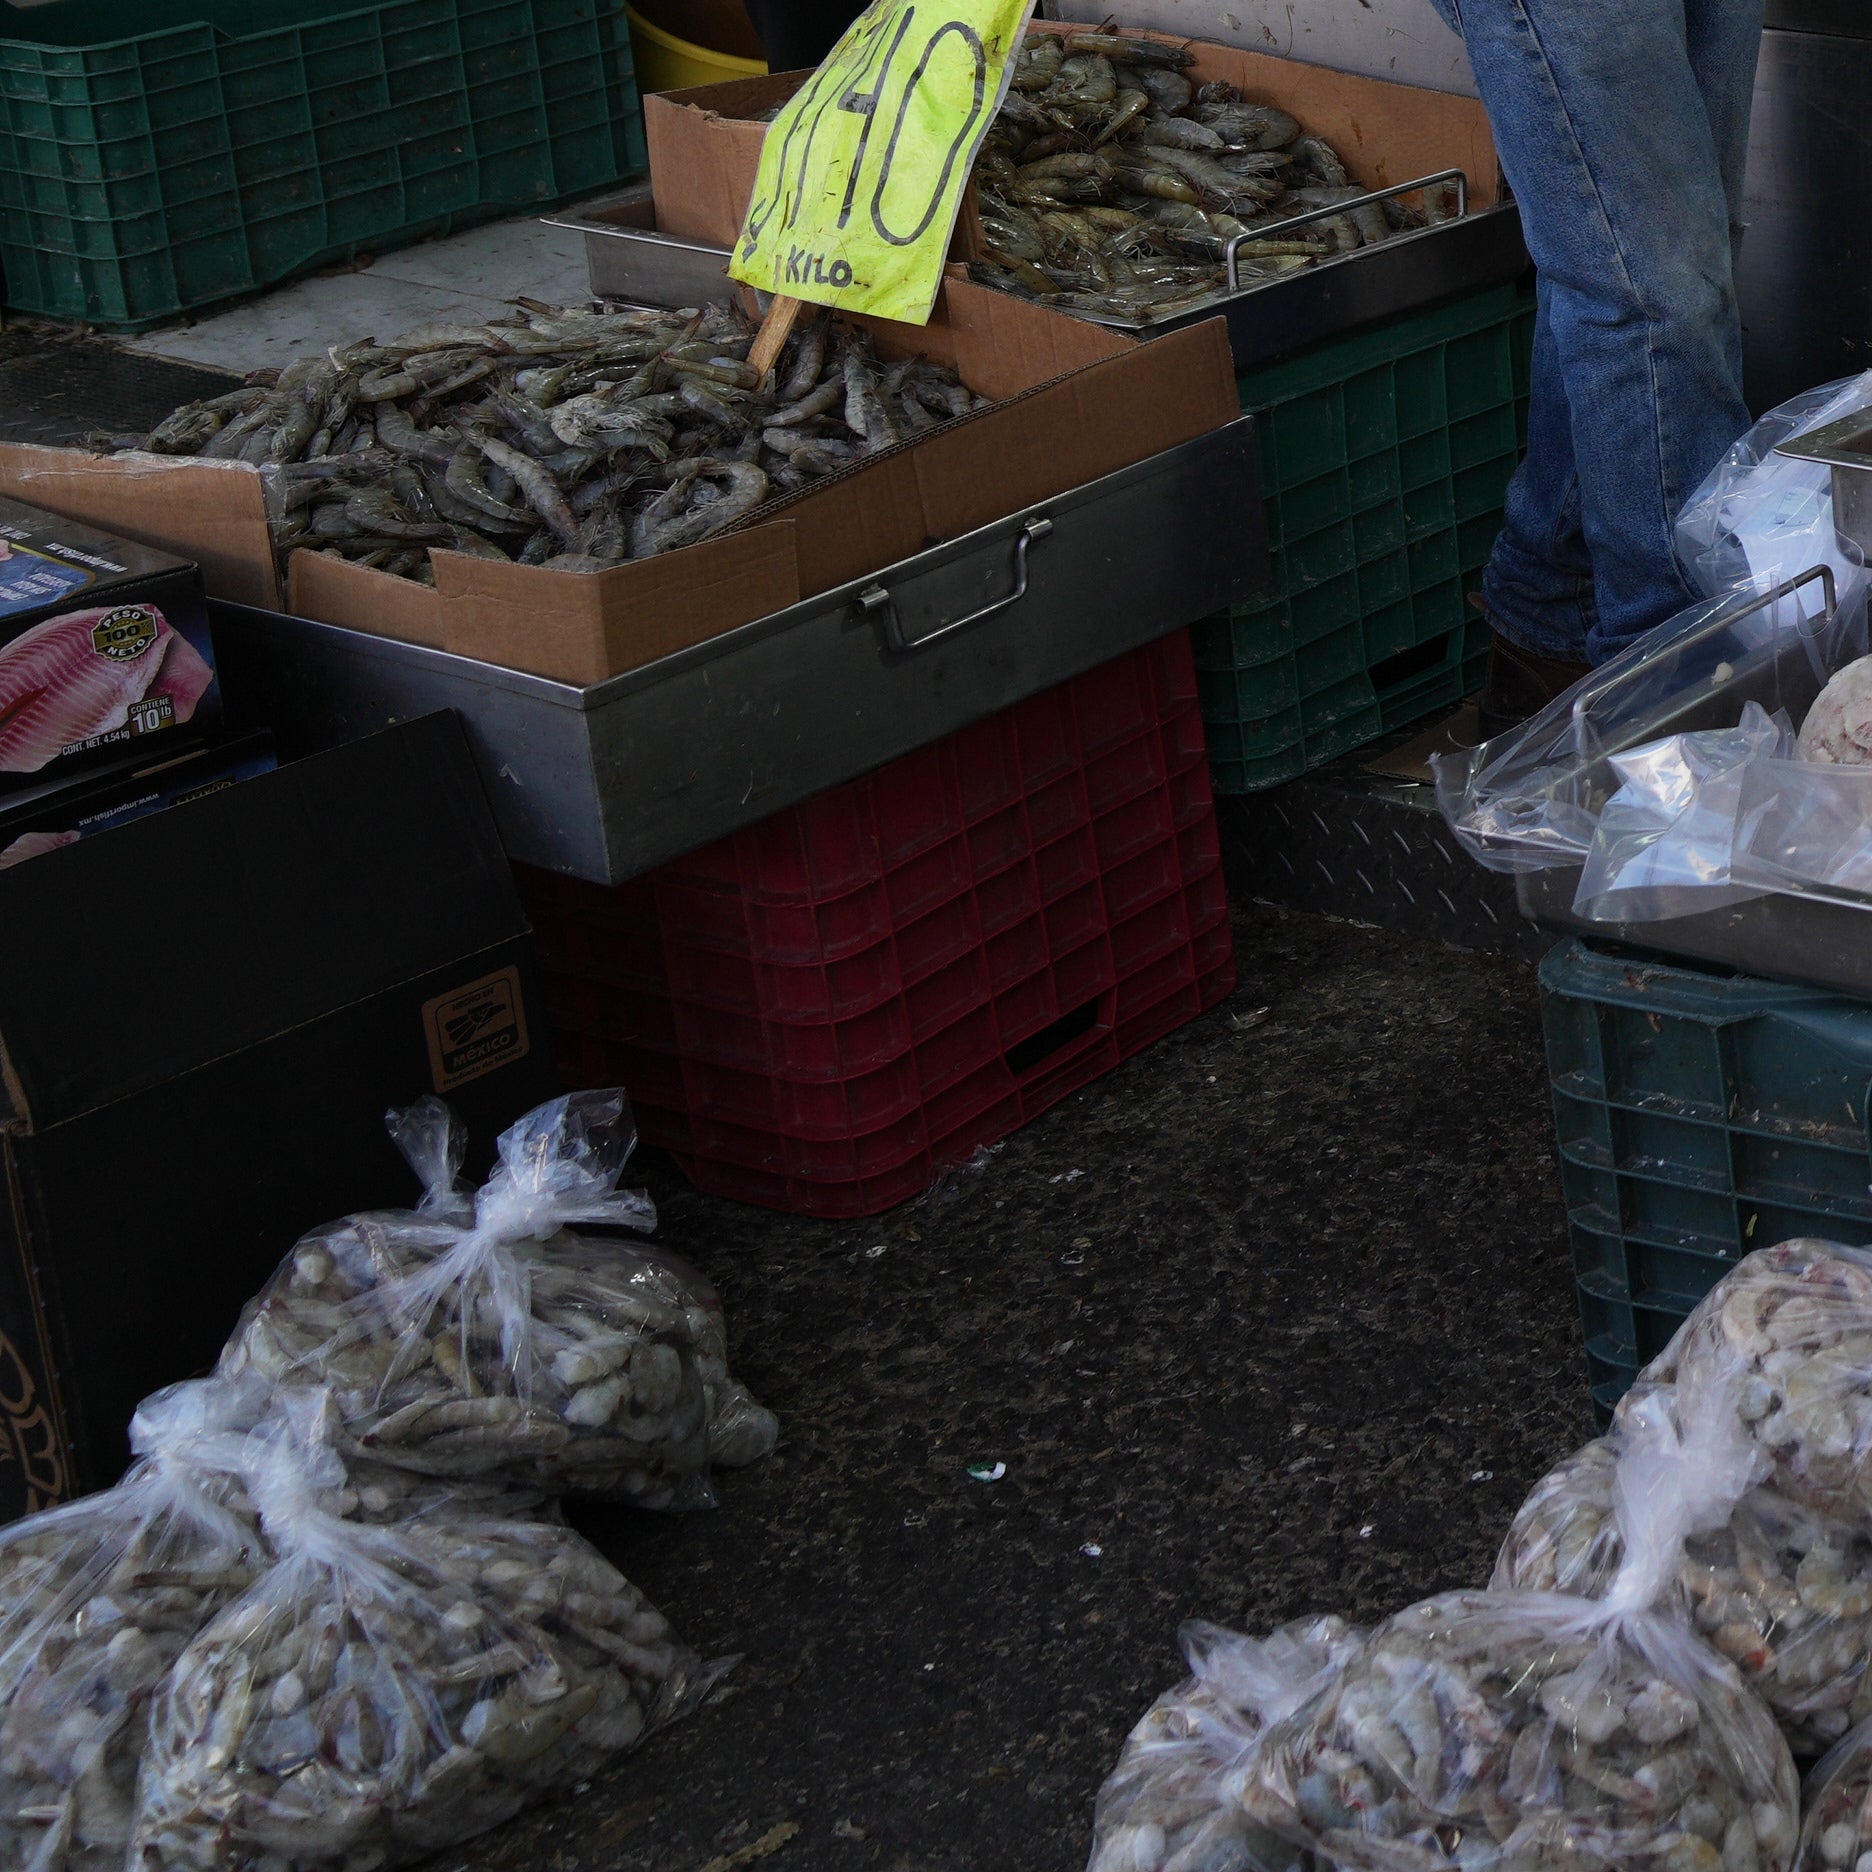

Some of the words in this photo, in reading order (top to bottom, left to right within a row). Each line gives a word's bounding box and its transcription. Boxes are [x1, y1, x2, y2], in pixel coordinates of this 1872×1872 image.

[785, 243, 853, 288] KILO
[102, 608, 142, 629] PESO
[106, 637, 146, 657] NETO
[130, 696, 171, 715] CONTIENE
[131, 709, 160, 734] 10
[62, 738, 86, 756] CONT.
[86, 735, 103, 752] NET.
[78, 791, 160, 827] www.importfish.mx
[452, 992, 481, 1011] HECHO
